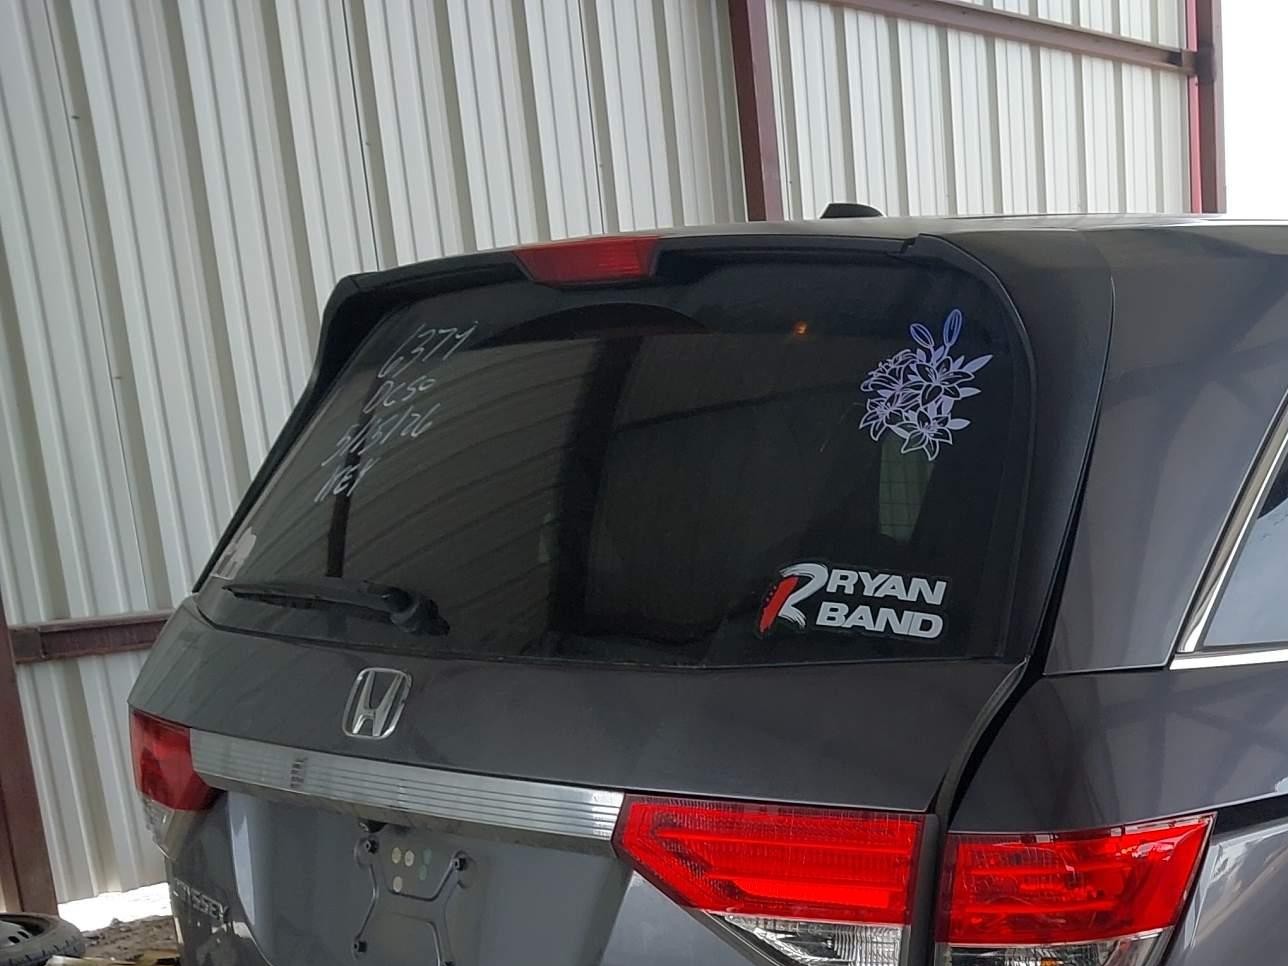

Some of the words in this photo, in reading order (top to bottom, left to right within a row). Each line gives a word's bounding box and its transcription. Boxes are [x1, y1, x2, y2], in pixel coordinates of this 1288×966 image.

[313, 456, 382, 502] KEY
[826, 568, 947, 606] RYAN
[815, 601, 944, 640] BAND
